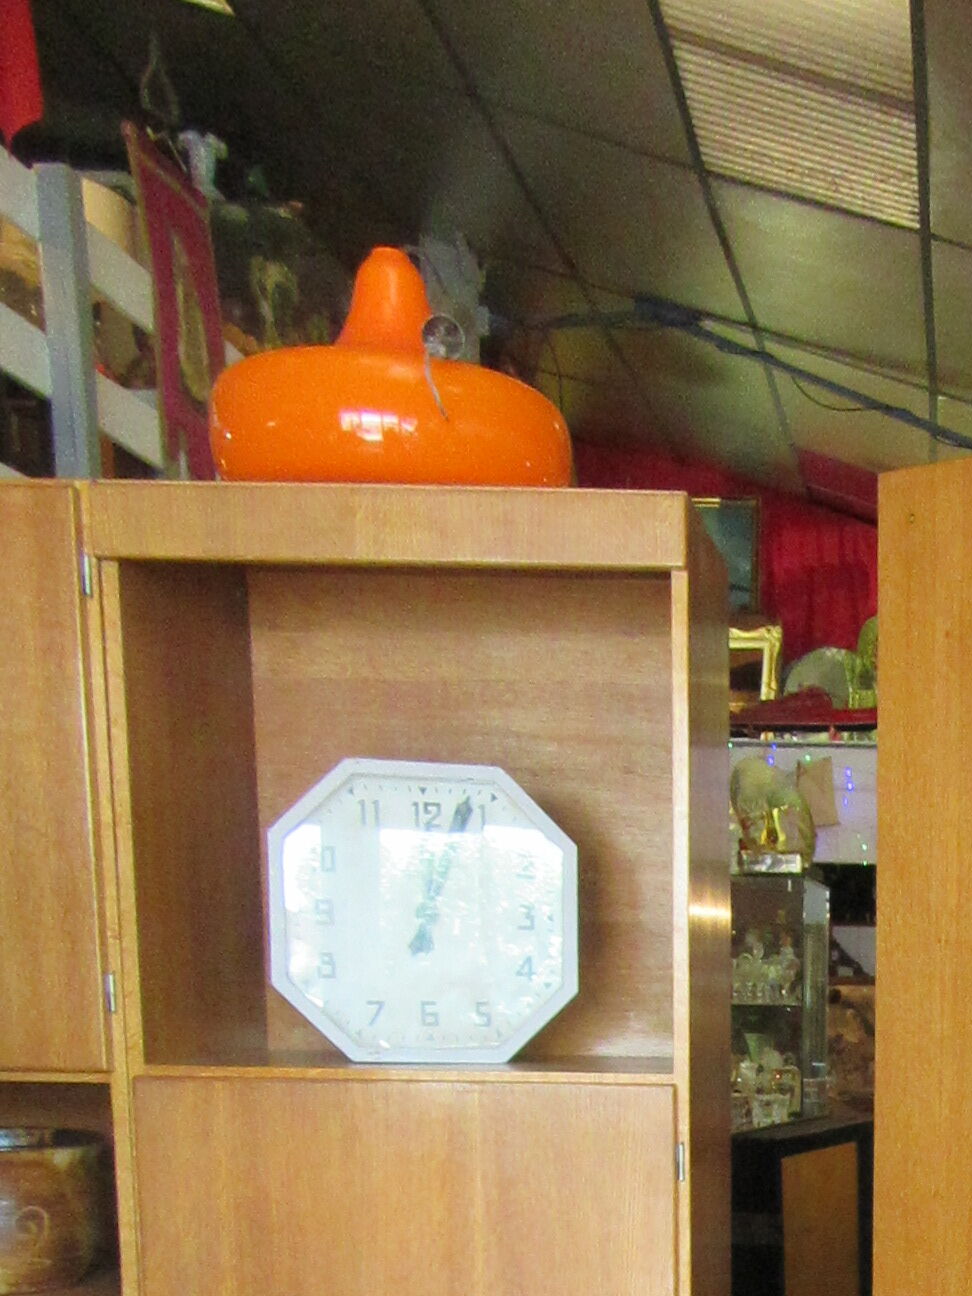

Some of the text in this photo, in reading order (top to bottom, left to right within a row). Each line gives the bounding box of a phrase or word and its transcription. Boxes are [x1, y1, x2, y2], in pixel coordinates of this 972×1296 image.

[357, 799, 380, 826] 11
[411, 802, 441, 829] 12
[477, 804, 486, 829] 1
[516, 904, 536, 931] 3
[515, 955, 536, 981] 4
[367, 1000, 385, 1026] 7
[420, 1001, 440, 1027] 6
[475, 1001, 491, 1027] 5
